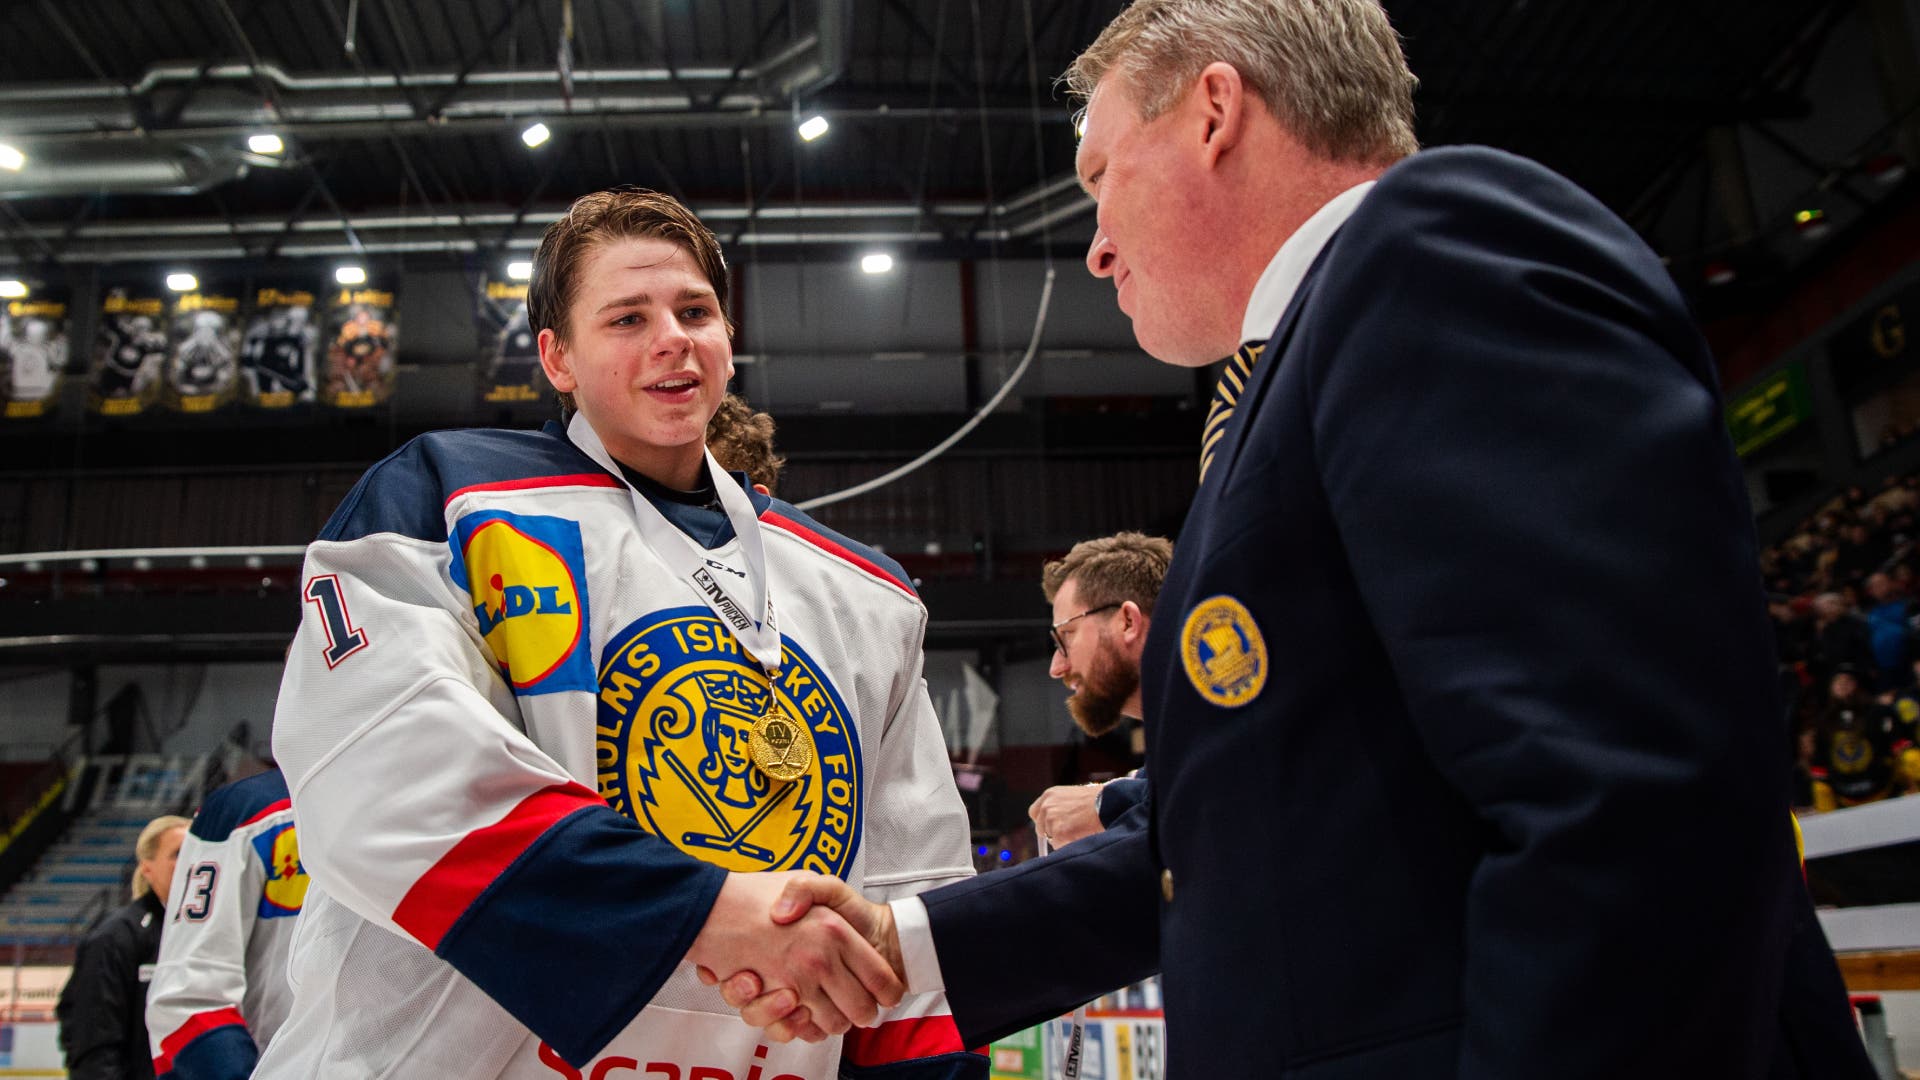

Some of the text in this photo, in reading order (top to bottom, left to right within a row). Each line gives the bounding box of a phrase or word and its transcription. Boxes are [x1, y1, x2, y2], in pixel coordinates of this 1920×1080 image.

[304, 574, 369, 671] 1
[720, 601, 750, 631] PUCKEN
[672, 623, 839, 735] ISHKEY
